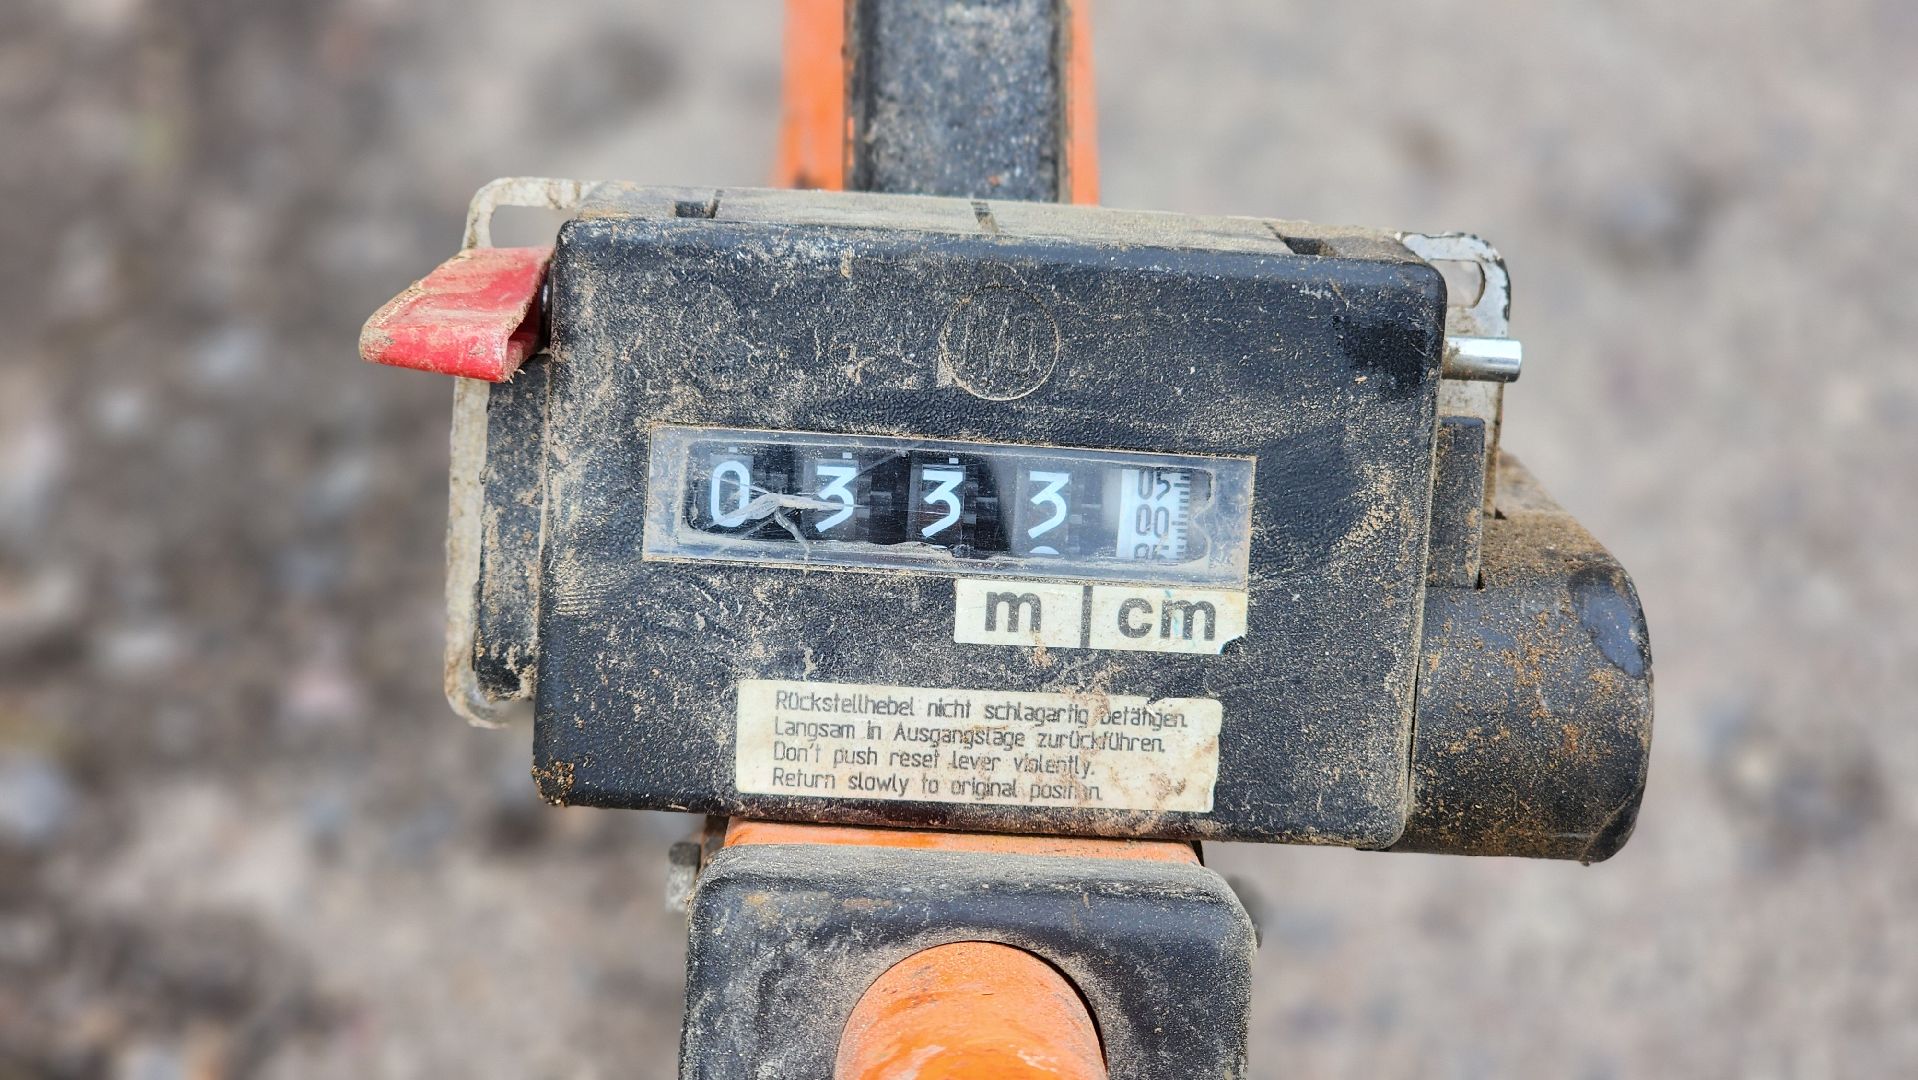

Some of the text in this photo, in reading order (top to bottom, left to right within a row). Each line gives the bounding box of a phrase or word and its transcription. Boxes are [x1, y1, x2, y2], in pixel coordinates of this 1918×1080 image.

[984, 591, 1042, 632] m
[1117, 597, 1216, 641] cm
[776, 690, 915, 718] Rückstellhebel
[927, 697, 971, 719] nicht
[984, 701, 1088, 728] schlagartig
[774, 716, 1165, 753] Langsam in Ausgangslage zurückführen.
[773, 741, 1095, 779] Don't push reset lever violently.
[772, 767, 835, 790] Return
[848, 772, 909, 797] slowly
[921, 774, 939, 794] to
[951, 777, 1017, 800] original
